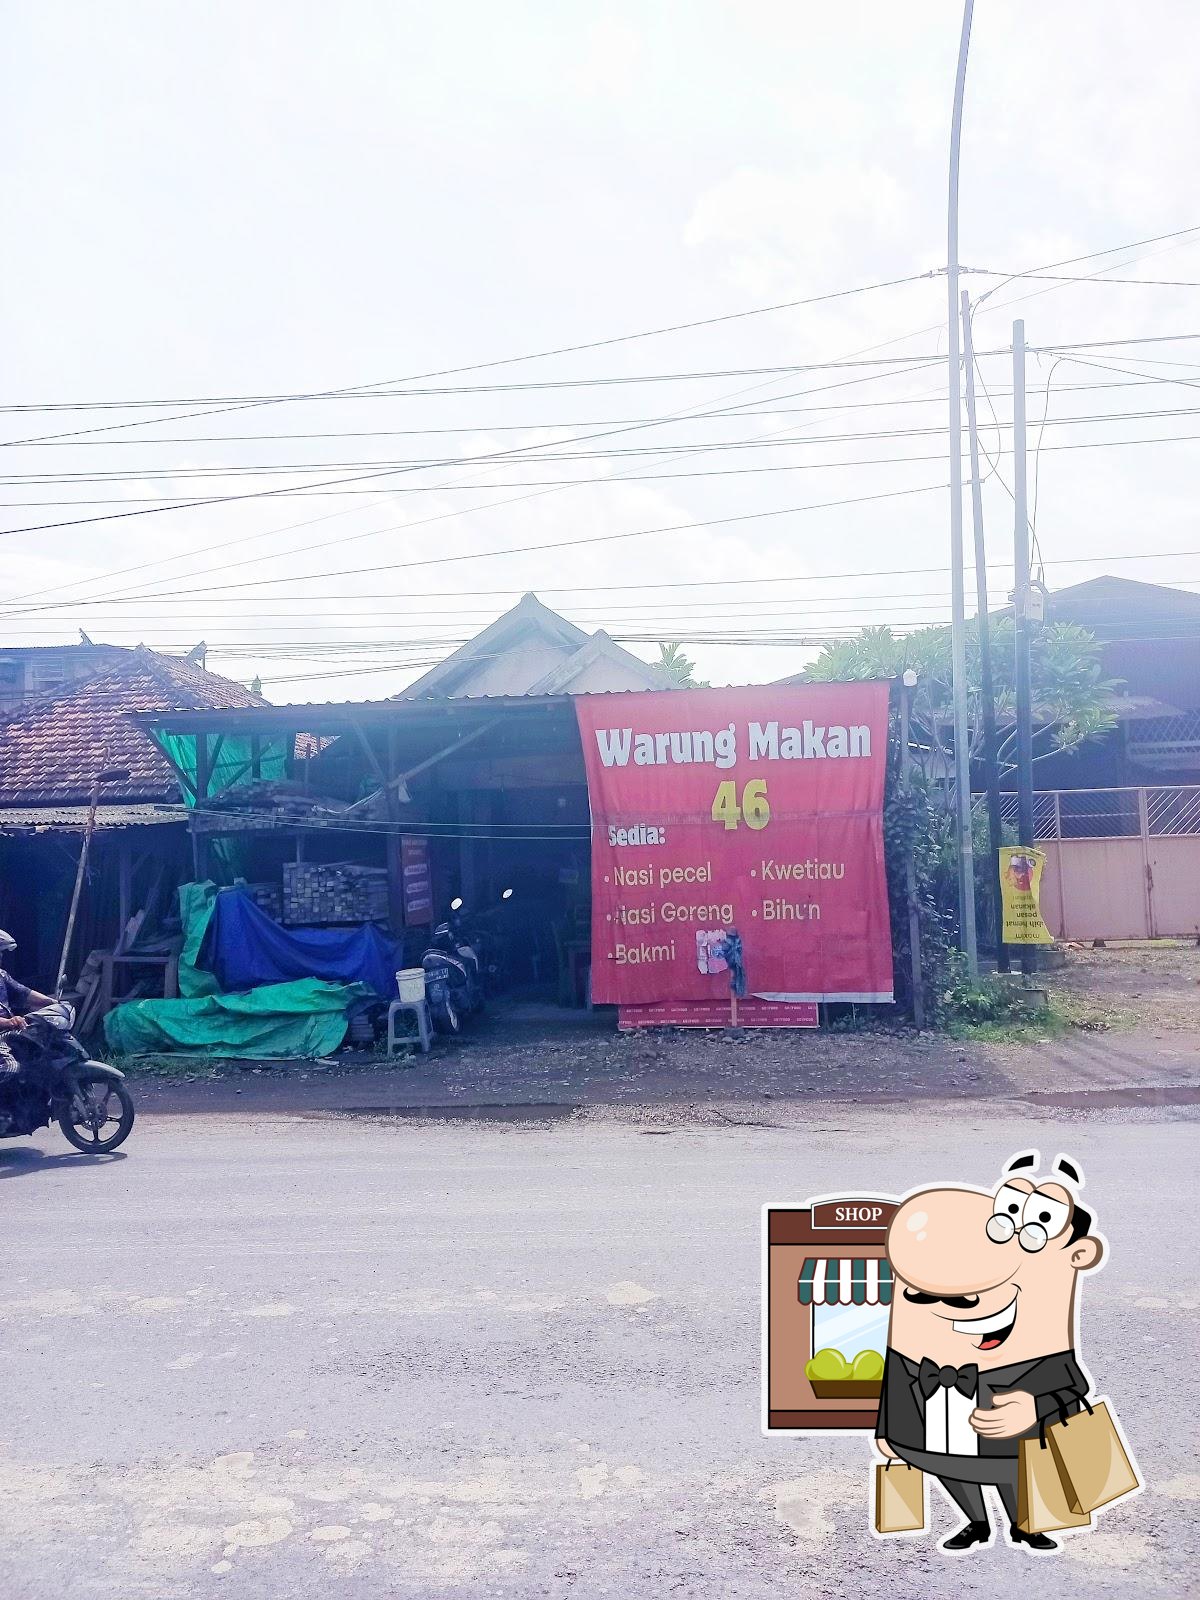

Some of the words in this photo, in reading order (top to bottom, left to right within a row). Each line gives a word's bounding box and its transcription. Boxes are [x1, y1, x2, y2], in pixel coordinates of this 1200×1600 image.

[595, 723, 737, 769] Warung
[748, 720, 872, 761] Makan
[711, 779, 770, 830] 46
[608, 824, 666, 847] Sedia:
[614, 864, 654, 886] Nasi
[660, 861, 712, 889] pecel
[761, 859, 846, 880] Kwetiau
[660, 901, 734, 925] Goreng
[615, 939, 676, 965] Bakmi
